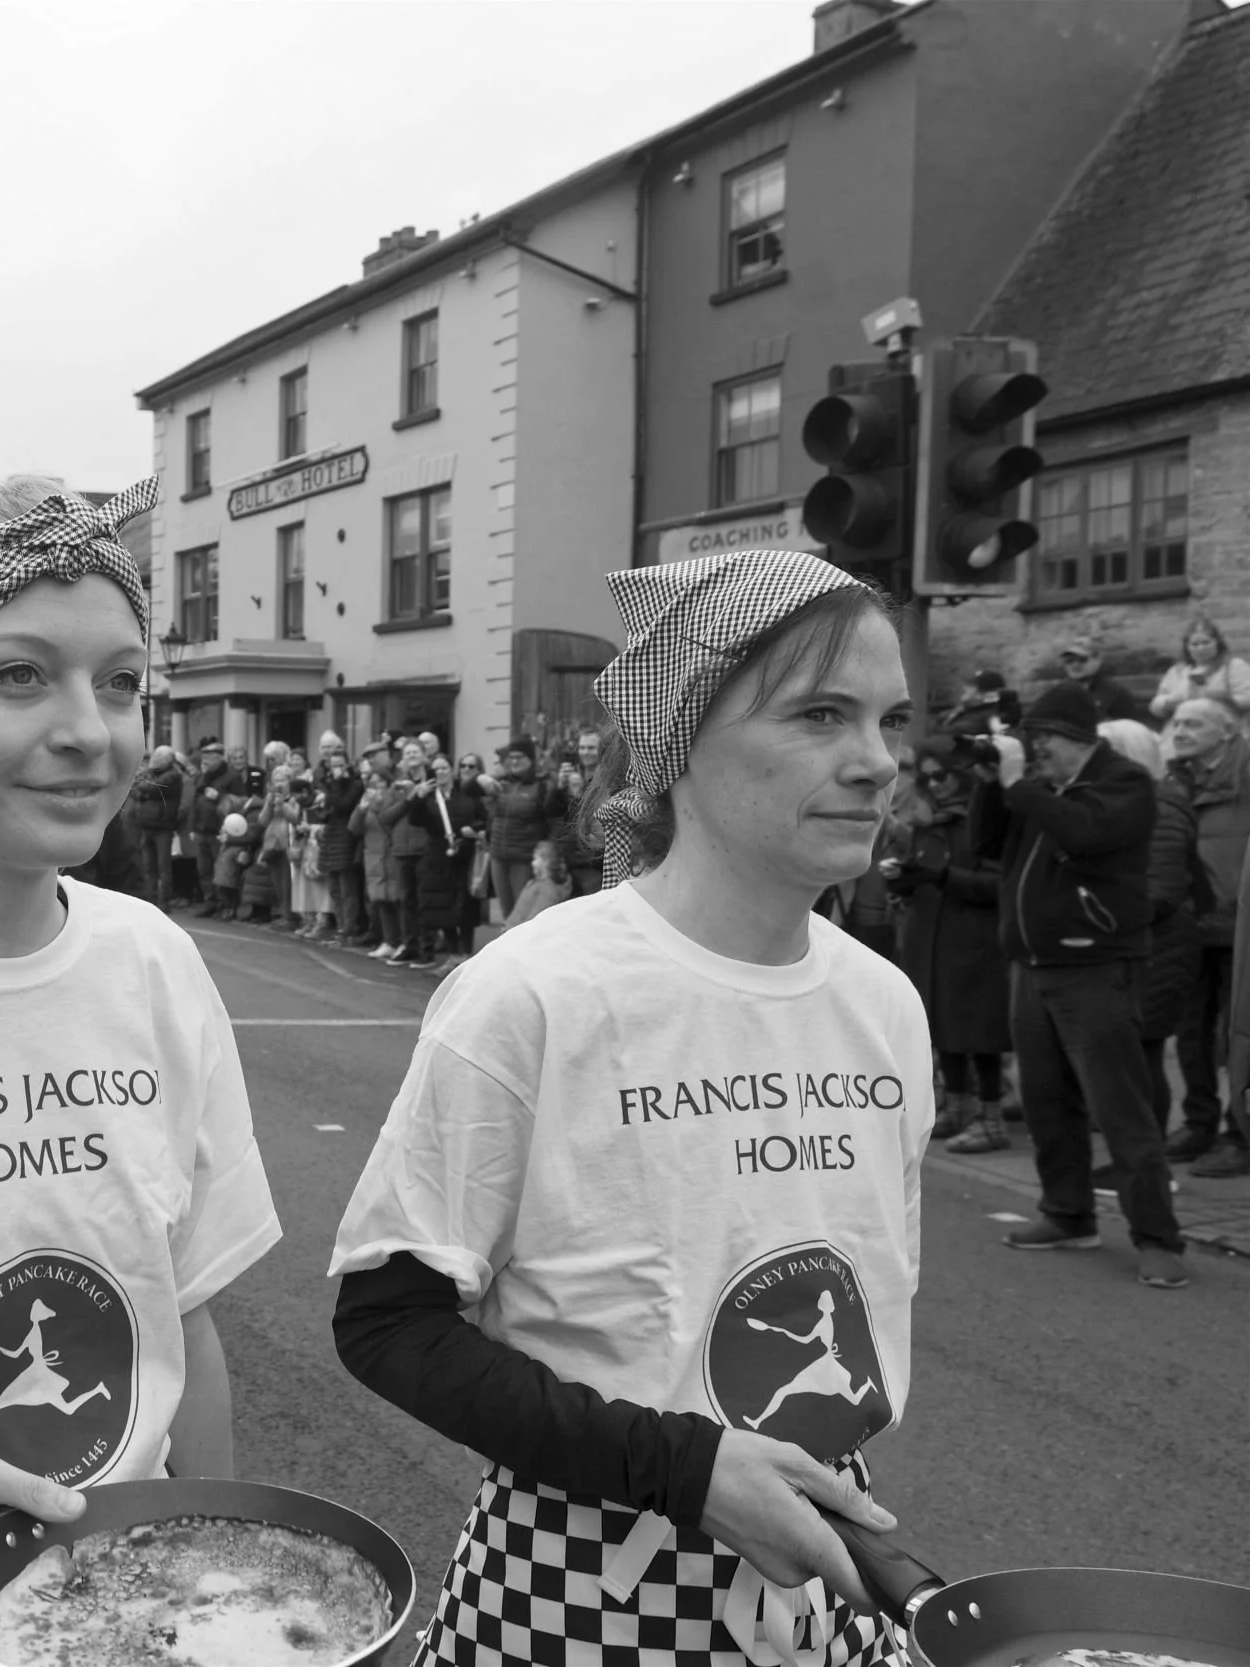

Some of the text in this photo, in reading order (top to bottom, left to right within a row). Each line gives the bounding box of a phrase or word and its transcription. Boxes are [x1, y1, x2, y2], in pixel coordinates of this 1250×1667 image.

[234, 454, 358, 513] BULL HOTEL
[689, 521, 788, 553] COACHING
[22, 1069, 162, 1124] JACKSO
[619, 1072, 907, 1126] FRANCIS JACKSO
[735, 1134, 856, 1175] HOMES
[8, 1264, 77, 1292] PANCAKE
[76, 1271, 113, 1313] RACE
[734, 1267, 785, 1311] OLNEY
[44, 1438, 109, 1485] Since 1445
